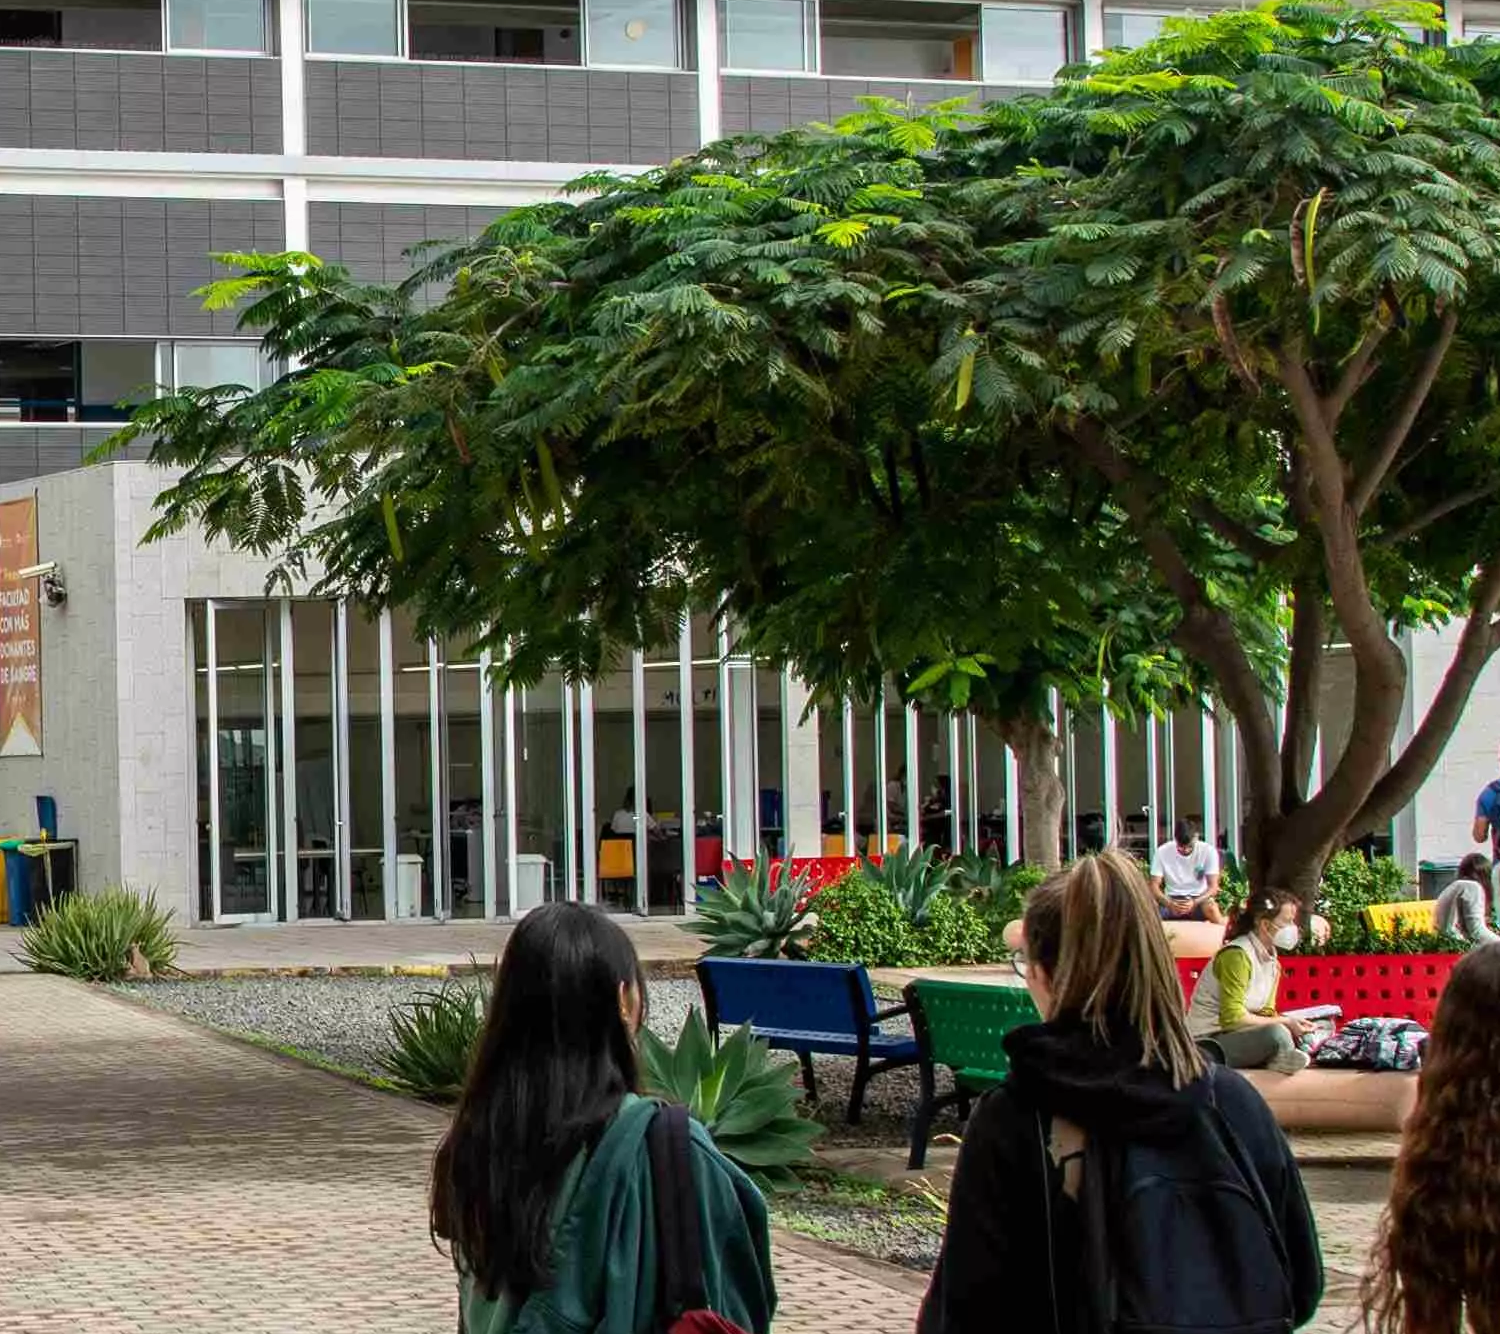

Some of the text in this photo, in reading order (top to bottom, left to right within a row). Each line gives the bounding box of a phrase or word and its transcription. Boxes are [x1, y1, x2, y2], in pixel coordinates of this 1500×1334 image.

[0, 587, 30, 607] FACULTAD
[0, 615, 13, 634] CON
[0, 639, 36, 660] DONANTES
[0, 667, 9, 684] DE
